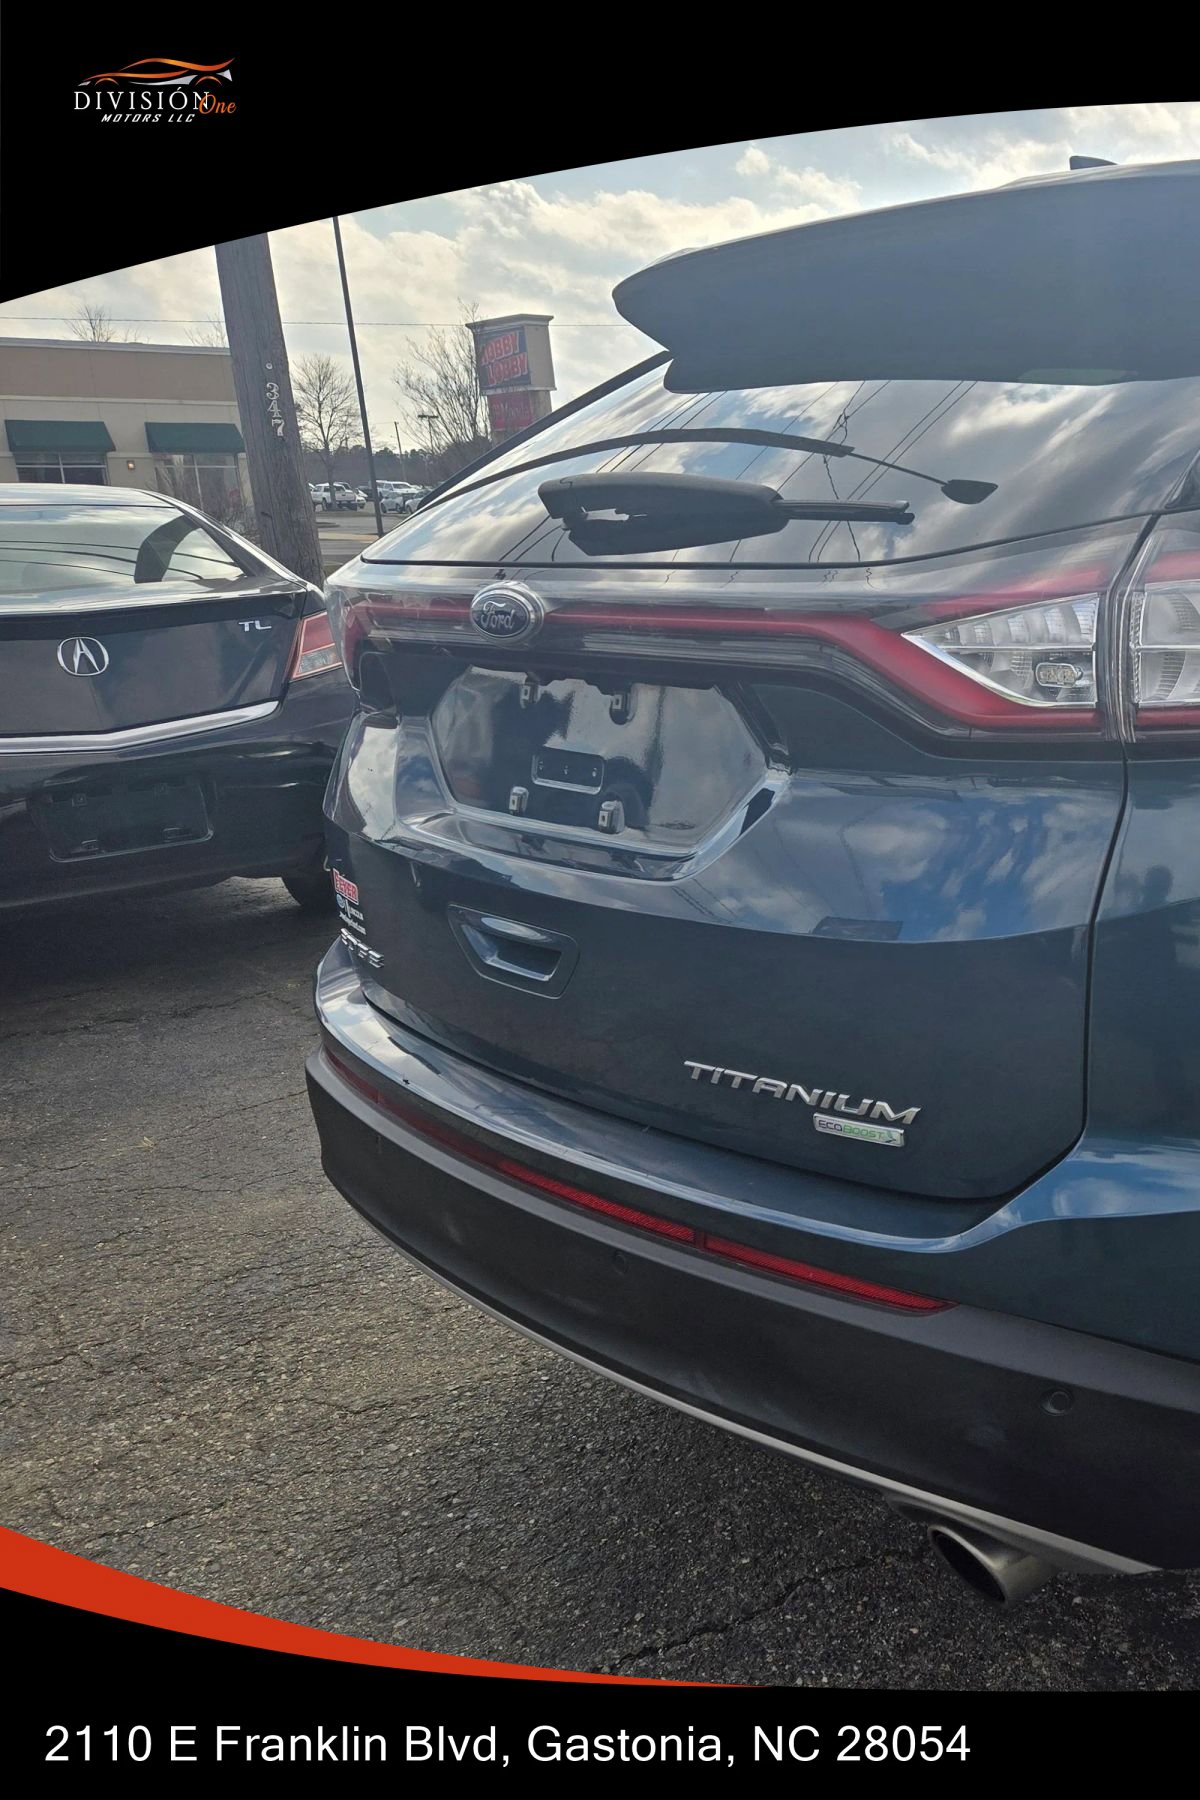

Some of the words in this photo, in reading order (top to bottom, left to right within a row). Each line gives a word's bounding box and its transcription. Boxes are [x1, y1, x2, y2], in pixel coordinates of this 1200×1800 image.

[488, 352, 529, 387] LOBBY
[266, 382, 285, 437] 347
[238, 620, 272, 632] TL
[481, 600, 515, 629] Ford
[683, 1060, 922, 1125] TITANIUM
